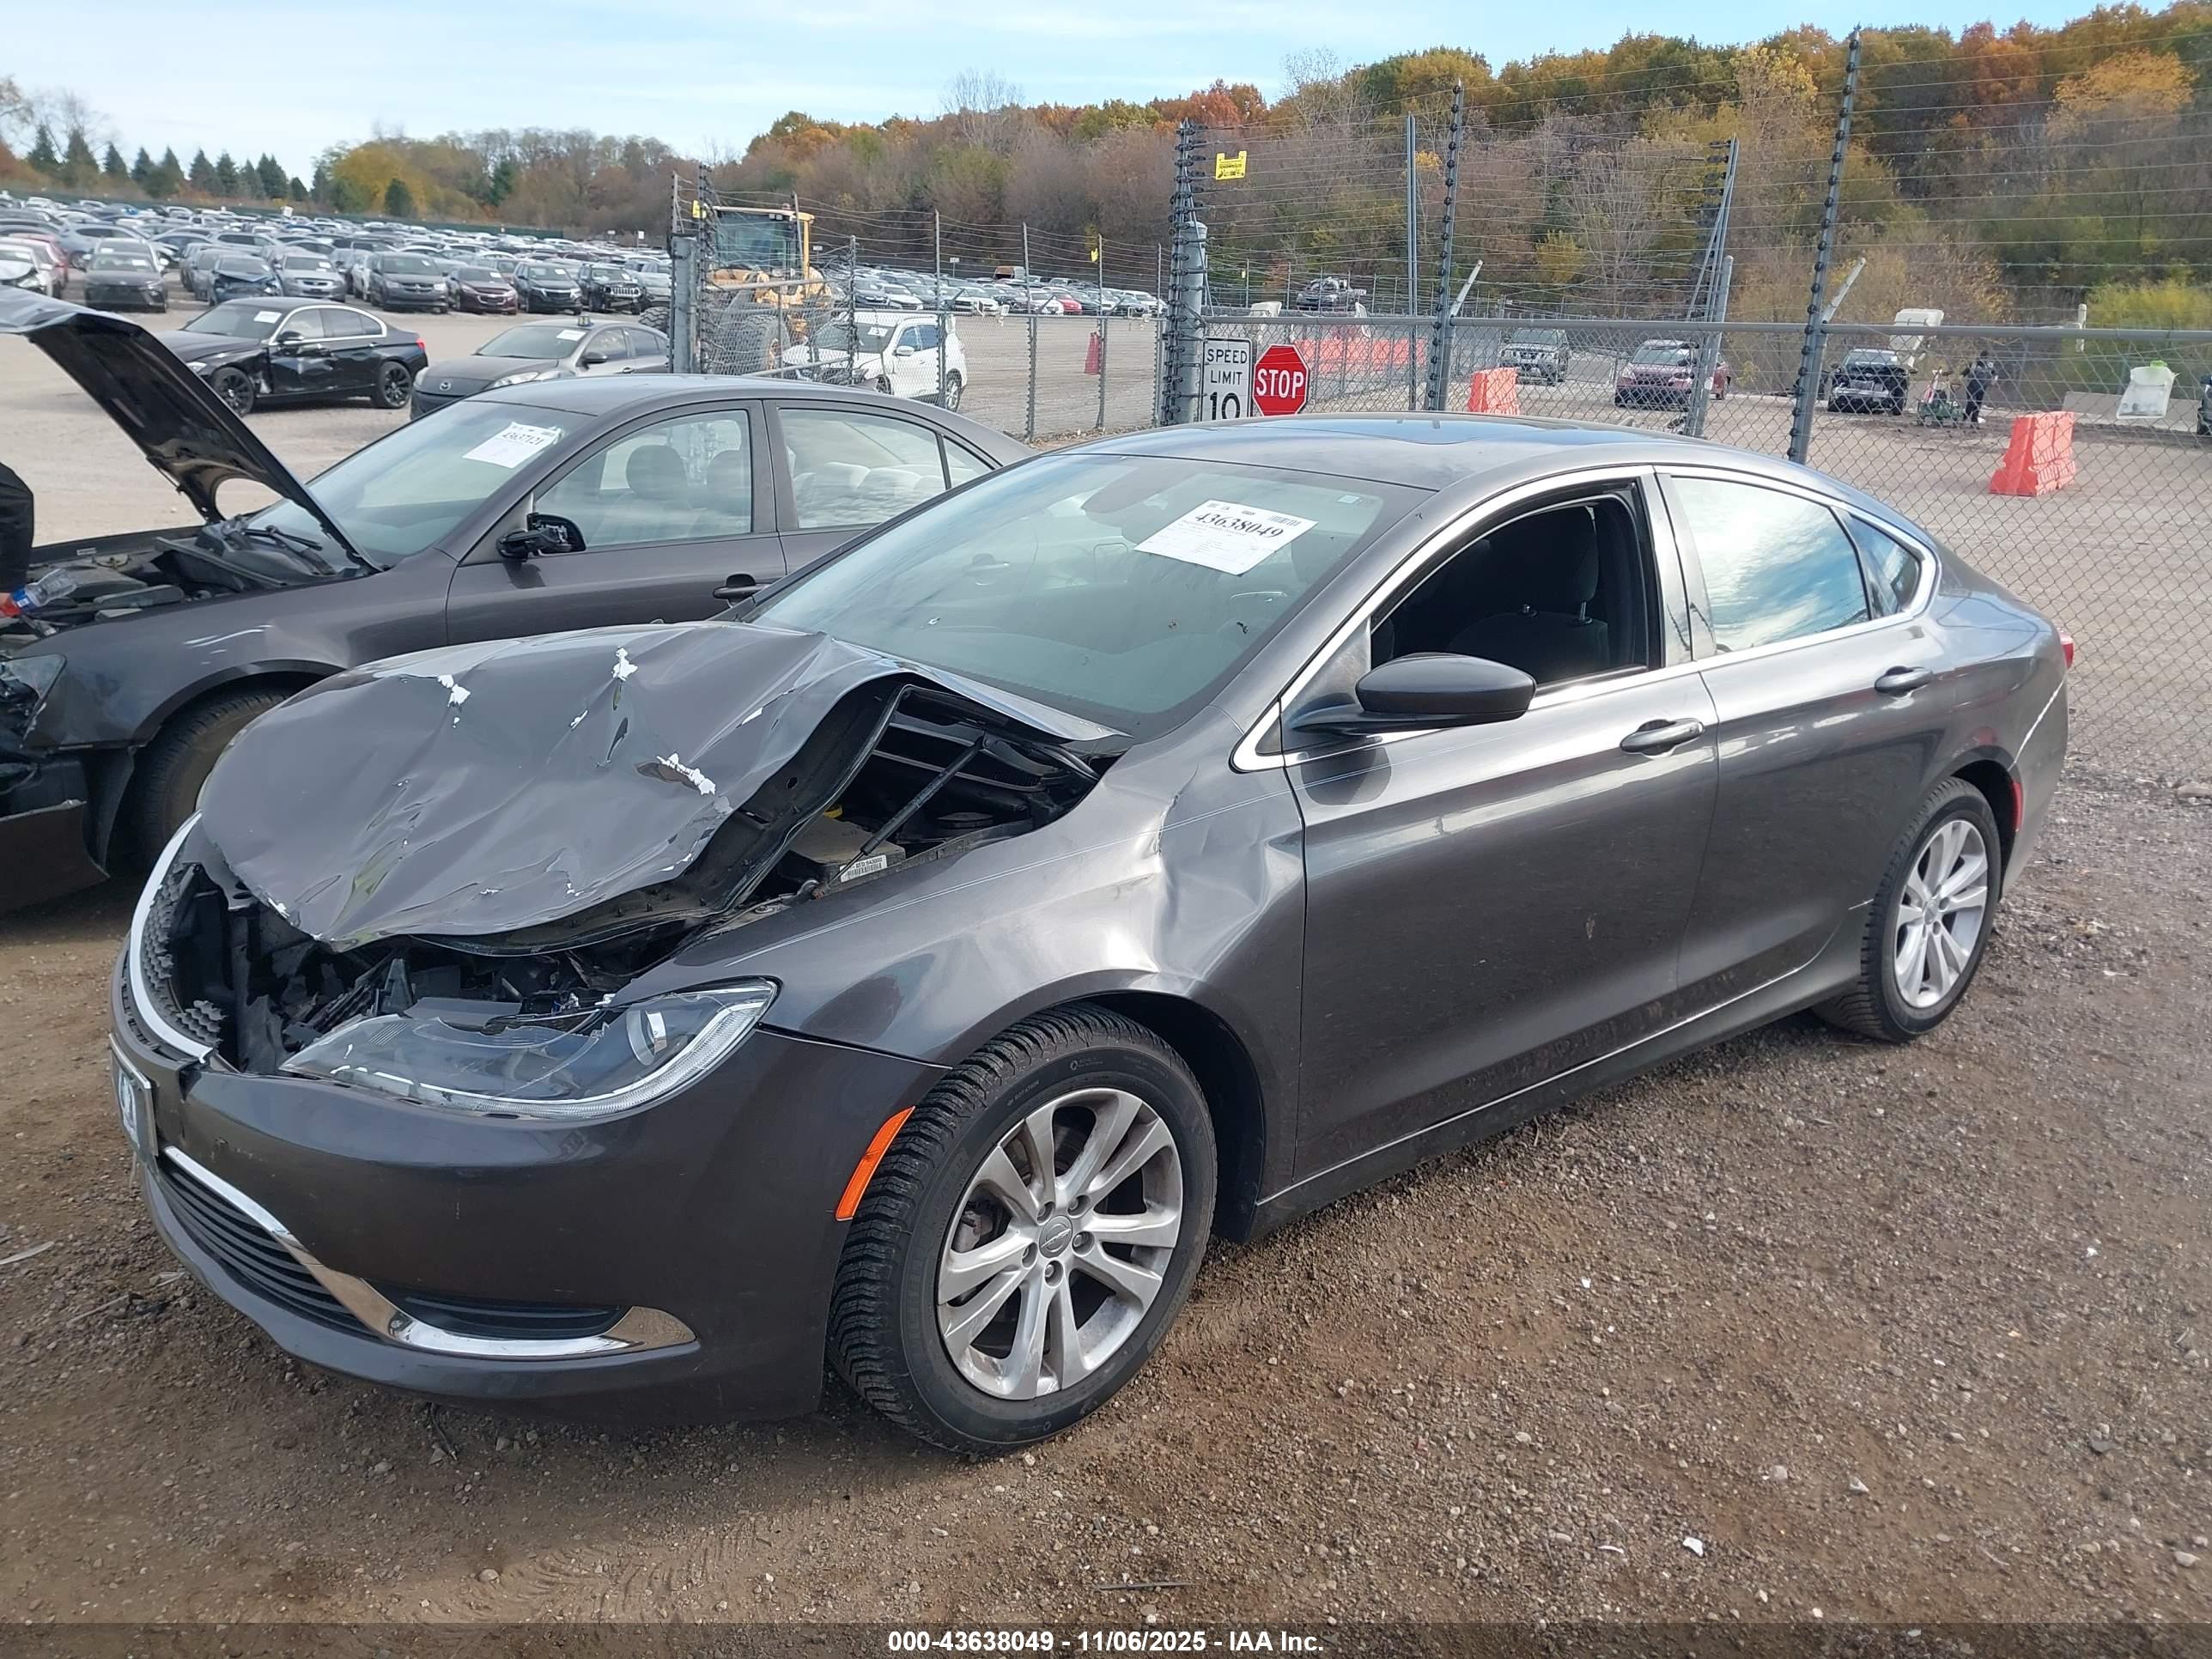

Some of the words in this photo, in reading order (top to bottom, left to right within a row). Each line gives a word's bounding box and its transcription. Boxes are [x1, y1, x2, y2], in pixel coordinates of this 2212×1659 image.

[1206, 349, 1248, 364] SPEED
[1210, 369, 1243, 386] LIMIT
[1256, 368, 1304, 399] STOP
[1209, 391, 1241, 420] 10
[1194, 512, 1284, 538] 43638049
